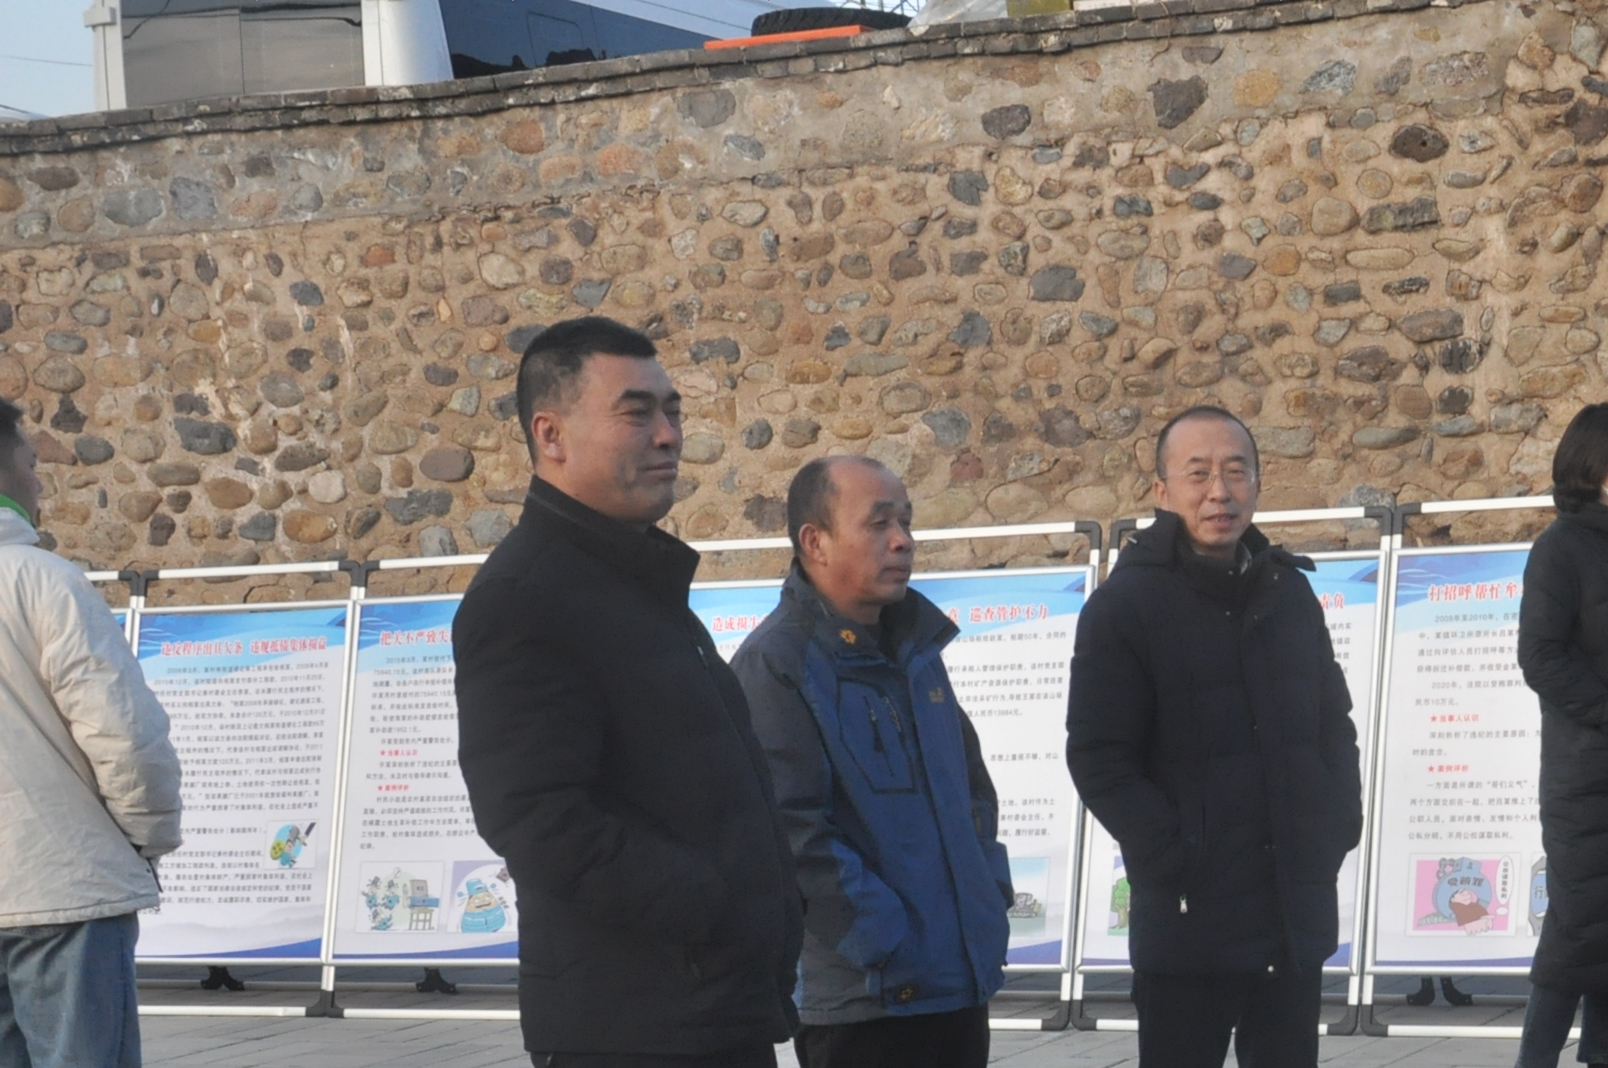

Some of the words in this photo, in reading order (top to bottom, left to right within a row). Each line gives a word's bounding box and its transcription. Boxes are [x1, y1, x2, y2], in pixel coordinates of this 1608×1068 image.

[1429, 582, 1524, 602] 打招呼帮忙牟
[970, 604, 1049, 623] 巡查管护不力
[1439, 714, 1480, 723] 当事人认识
[1437, 764, 1470, 773] 案例评析
